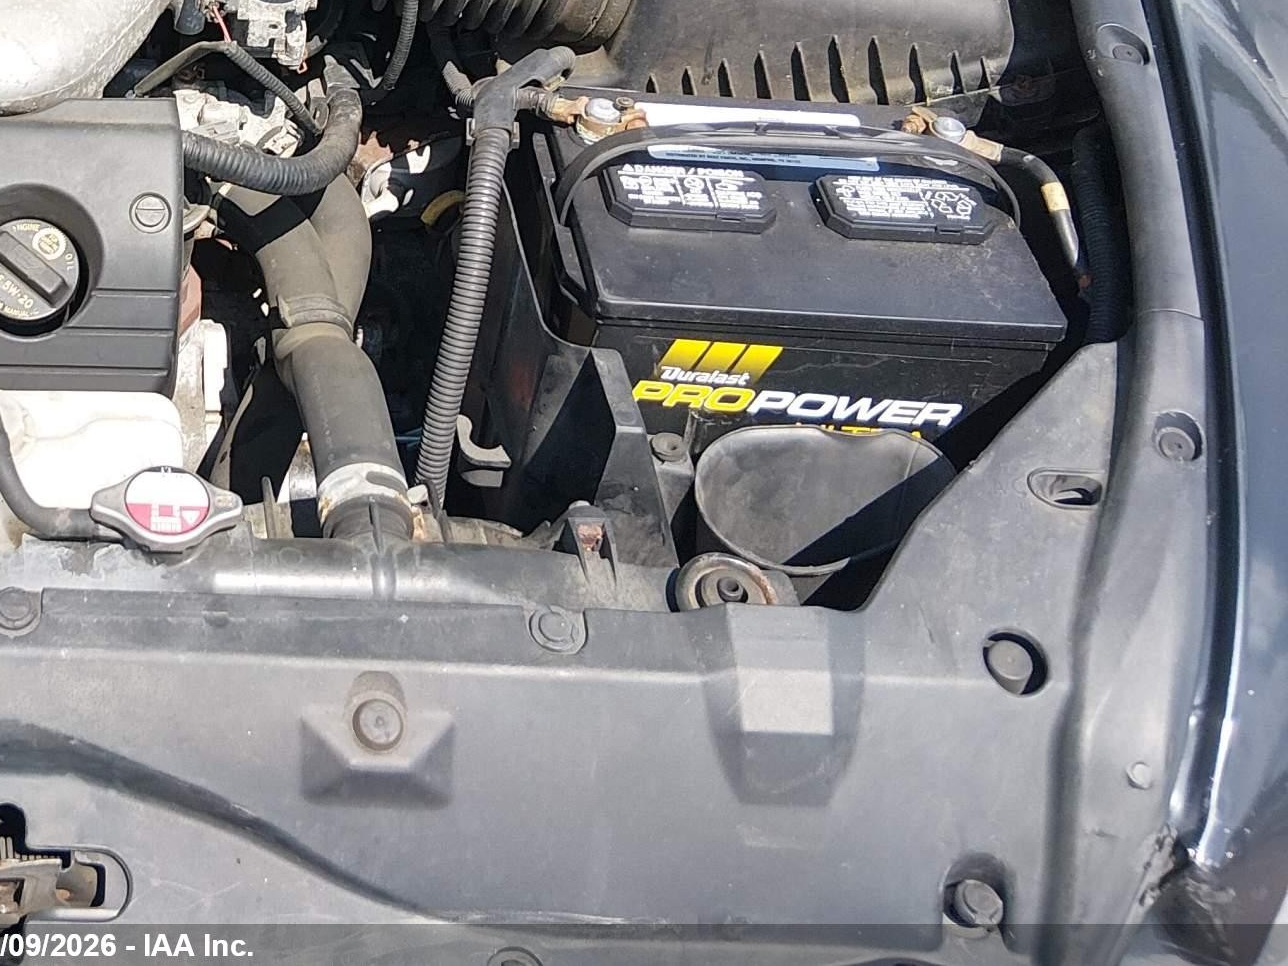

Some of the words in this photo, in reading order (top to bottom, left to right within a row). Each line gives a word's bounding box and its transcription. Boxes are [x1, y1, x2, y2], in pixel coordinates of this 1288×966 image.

[634, 164, 686, 175] DANGER
[697, 167, 745, 178] POISON
[65, 253, 75, 271] OIL
[661, 366, 751, 385] Duralast
[632, 380, 963, 428] PROPOWER
